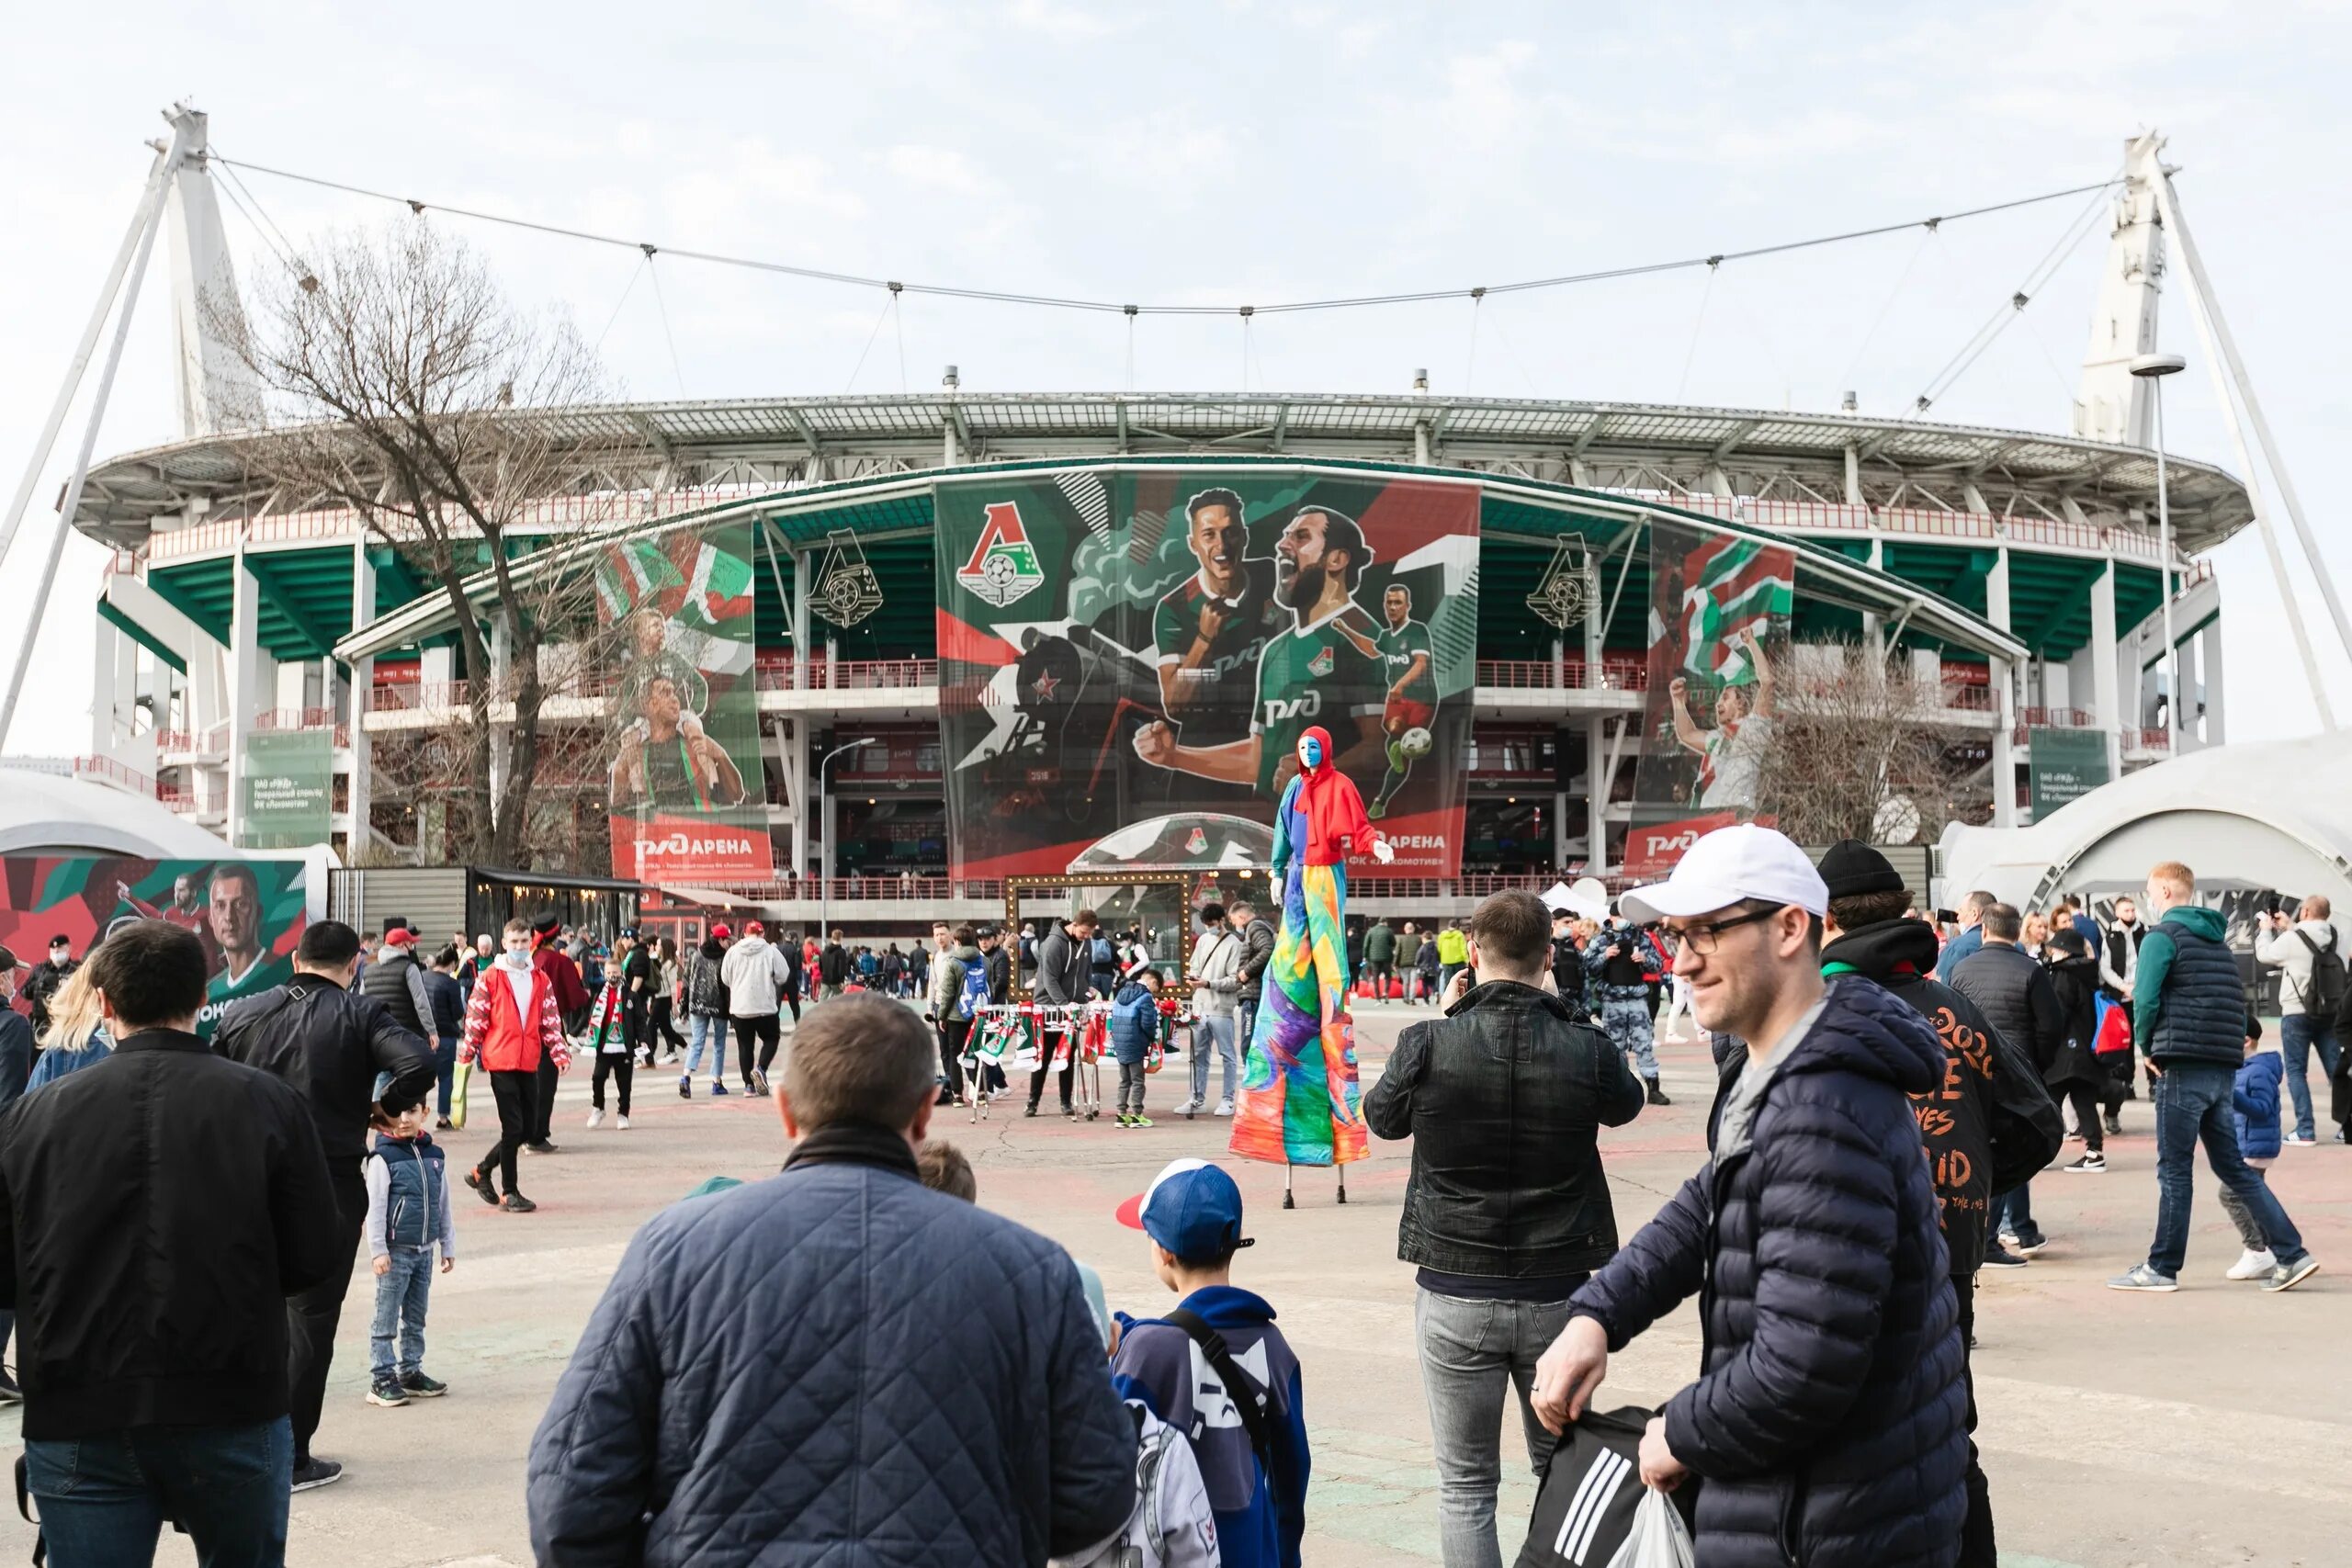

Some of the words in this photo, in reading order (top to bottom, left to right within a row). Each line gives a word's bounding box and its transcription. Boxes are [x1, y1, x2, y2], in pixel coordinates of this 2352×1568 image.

[691, 839, 752, 855] АРЕНА
[1387, 835, 1445, 849] АРЕНА
[1349, 855, 1367, 865] ФК
